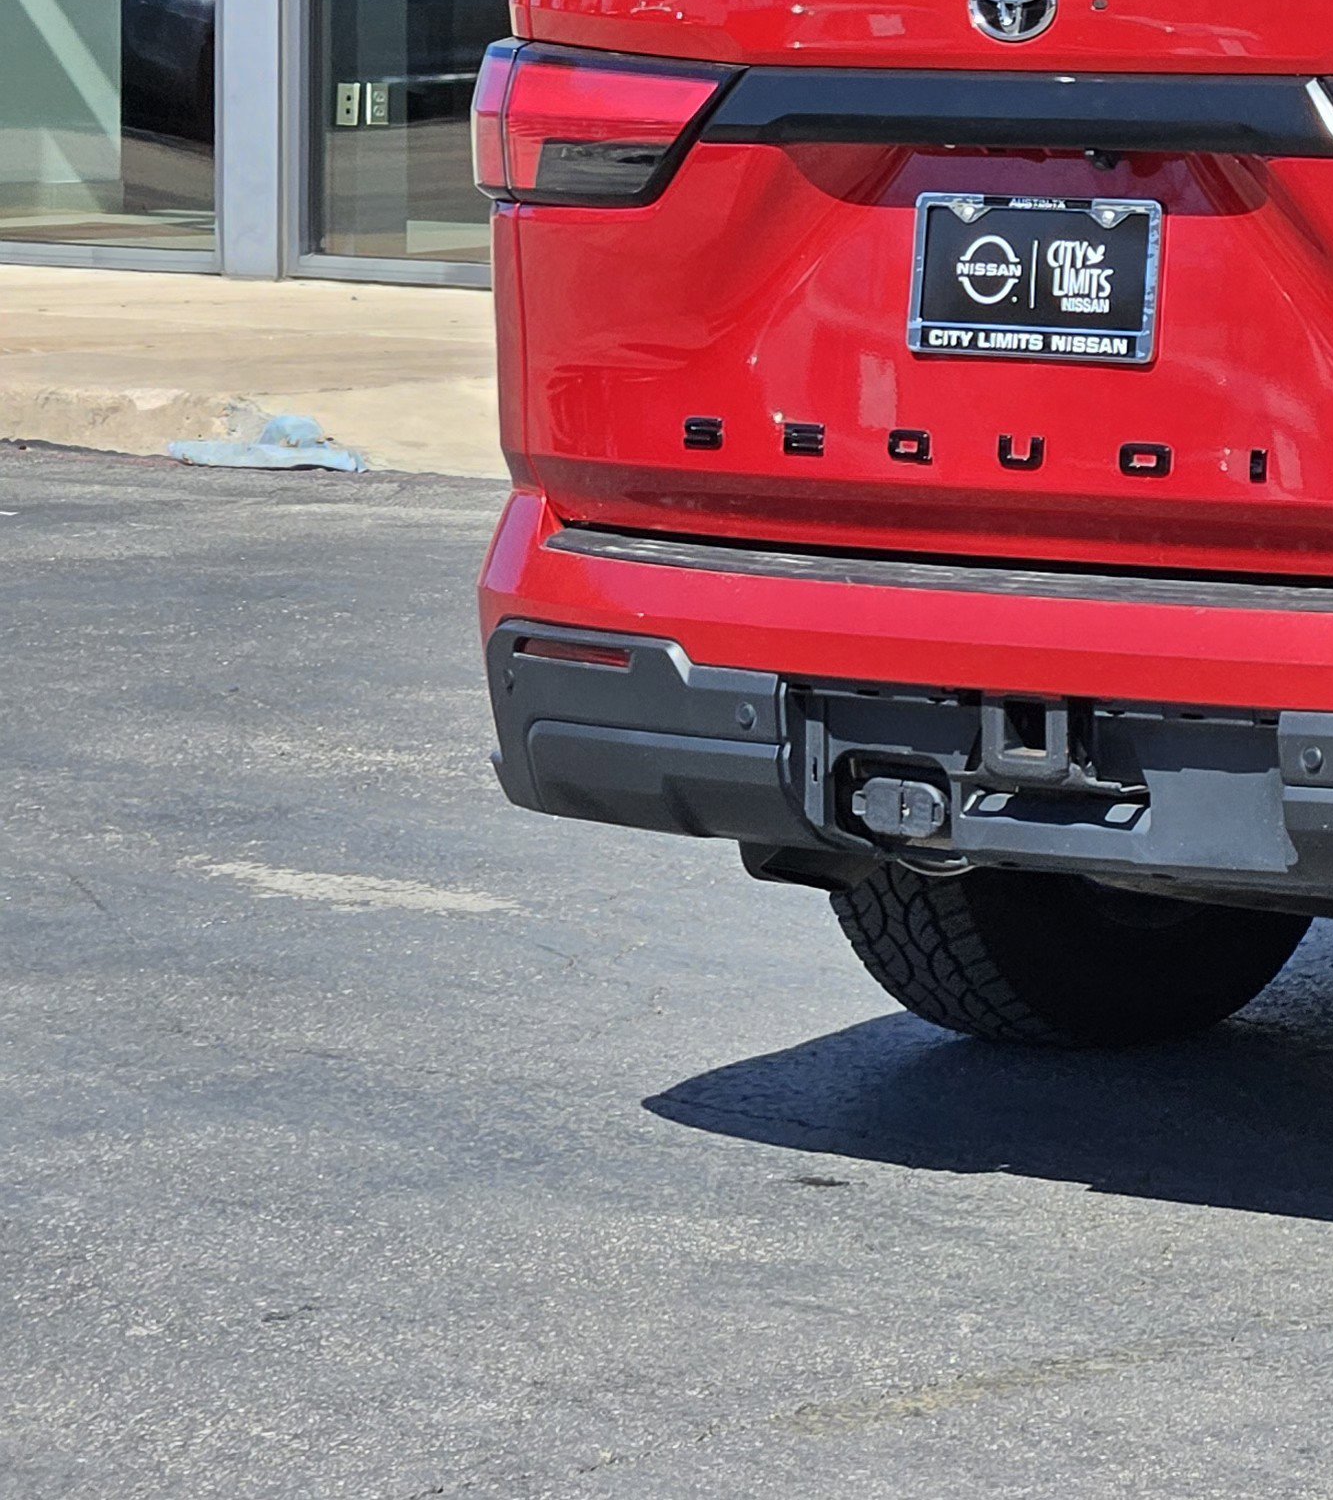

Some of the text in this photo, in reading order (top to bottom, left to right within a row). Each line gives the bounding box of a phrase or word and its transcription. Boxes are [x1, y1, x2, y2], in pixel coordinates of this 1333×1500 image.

[1047, 240, 1089, 268] CITY
[956, 262, 1022, 278] NISSAN
[1052, 268, 1114, 298] LIMITS
[1061, 298, 1110, 314] NISSAN
[928, 329, 1128, 355] CITY LIMITS NISSAN
